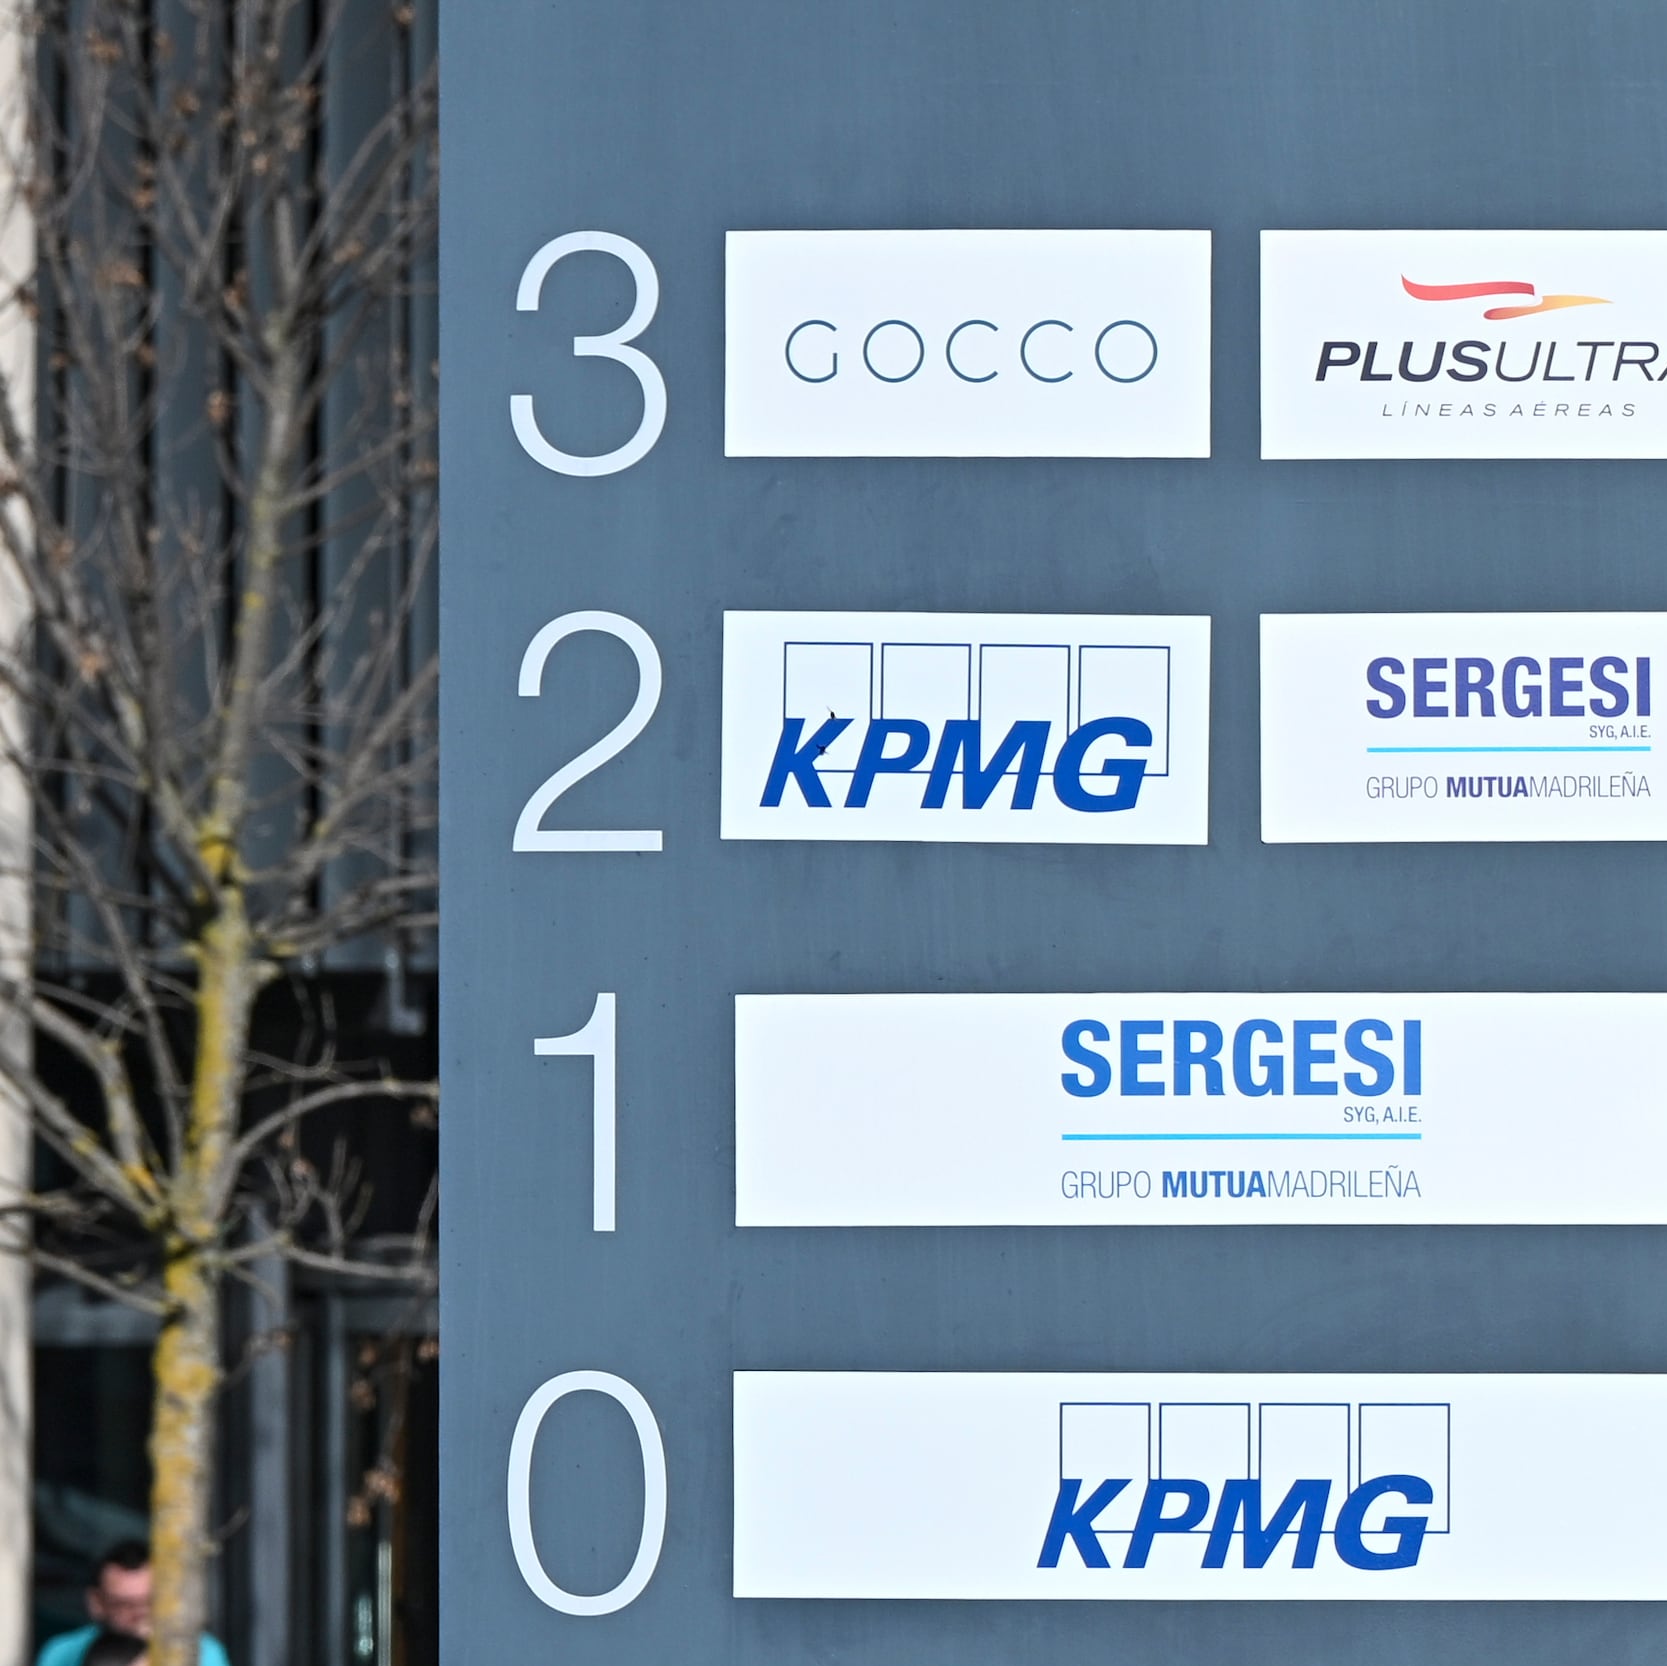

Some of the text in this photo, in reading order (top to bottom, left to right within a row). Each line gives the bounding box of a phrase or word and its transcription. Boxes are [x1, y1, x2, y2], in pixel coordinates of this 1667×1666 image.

[510, 230, 667, 477] 3
[784, 319, 1159, 384] GOCCO
[1382, 400, 1636, 417] LÍNEAS AÉREAS
[1366, 656, 1651, 719] SERGESI
[512, 610, 663, 852] 2
[760, 716, 1154, 814] KPMG
[1366, 771, 1652, 799] GRUPO MUTUAMADRILEÑA
[1061, 1019, 1422, 1098] SERGESI
[534, 992, 616, 1232] 1
[1343, 1105, 1422, 1126] SYG, A.I.E.
[1061, 1165, 1422, 1199] GRUPO MUTUAMADRILEÑA
[507, 1370, 667, 1616] 0
[1037, 1474, 1435, 1572] KPMG
